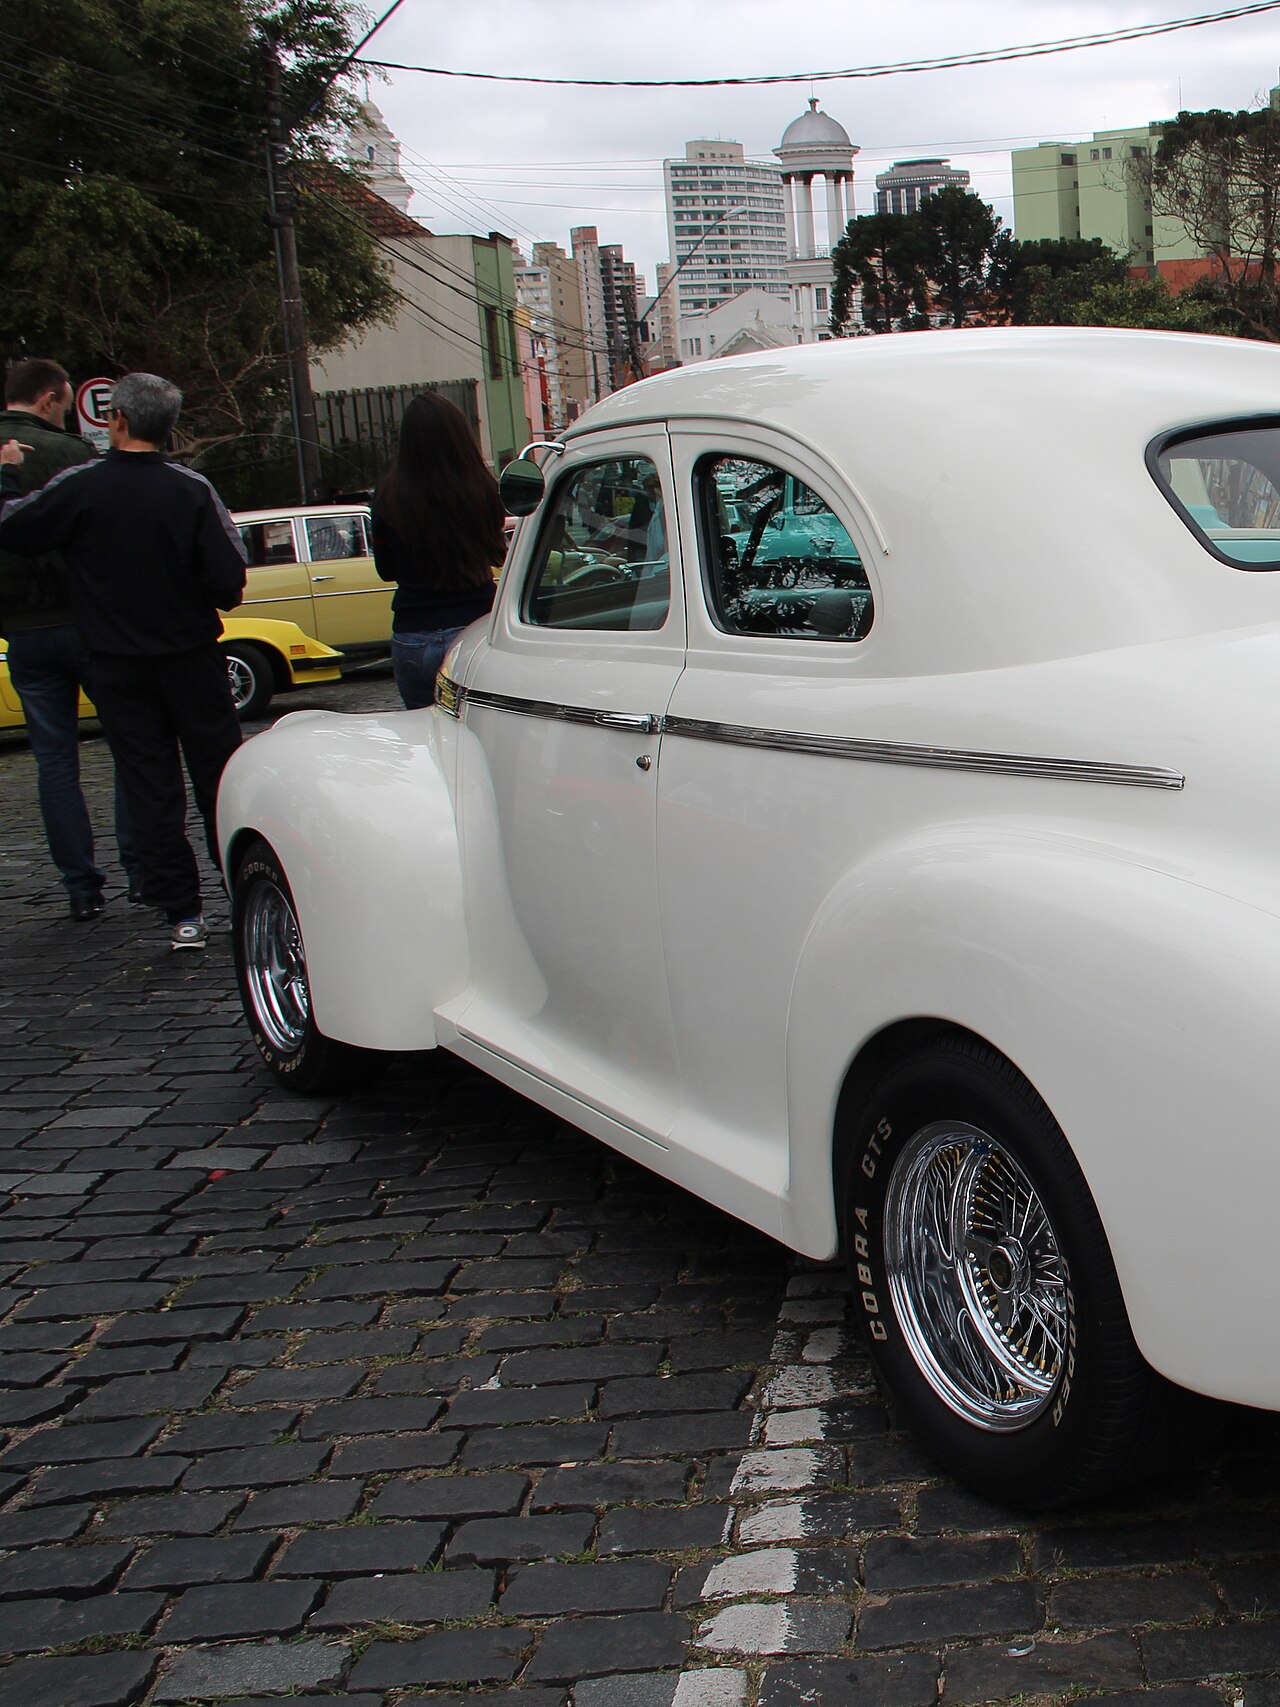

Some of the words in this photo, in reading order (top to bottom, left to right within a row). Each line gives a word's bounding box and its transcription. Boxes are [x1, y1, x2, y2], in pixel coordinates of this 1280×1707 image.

[243, 861, 278, 881] COOPER
[862, 1117, 892, 1178] GTS
[855, 1207, 888, 1341] COBRA
